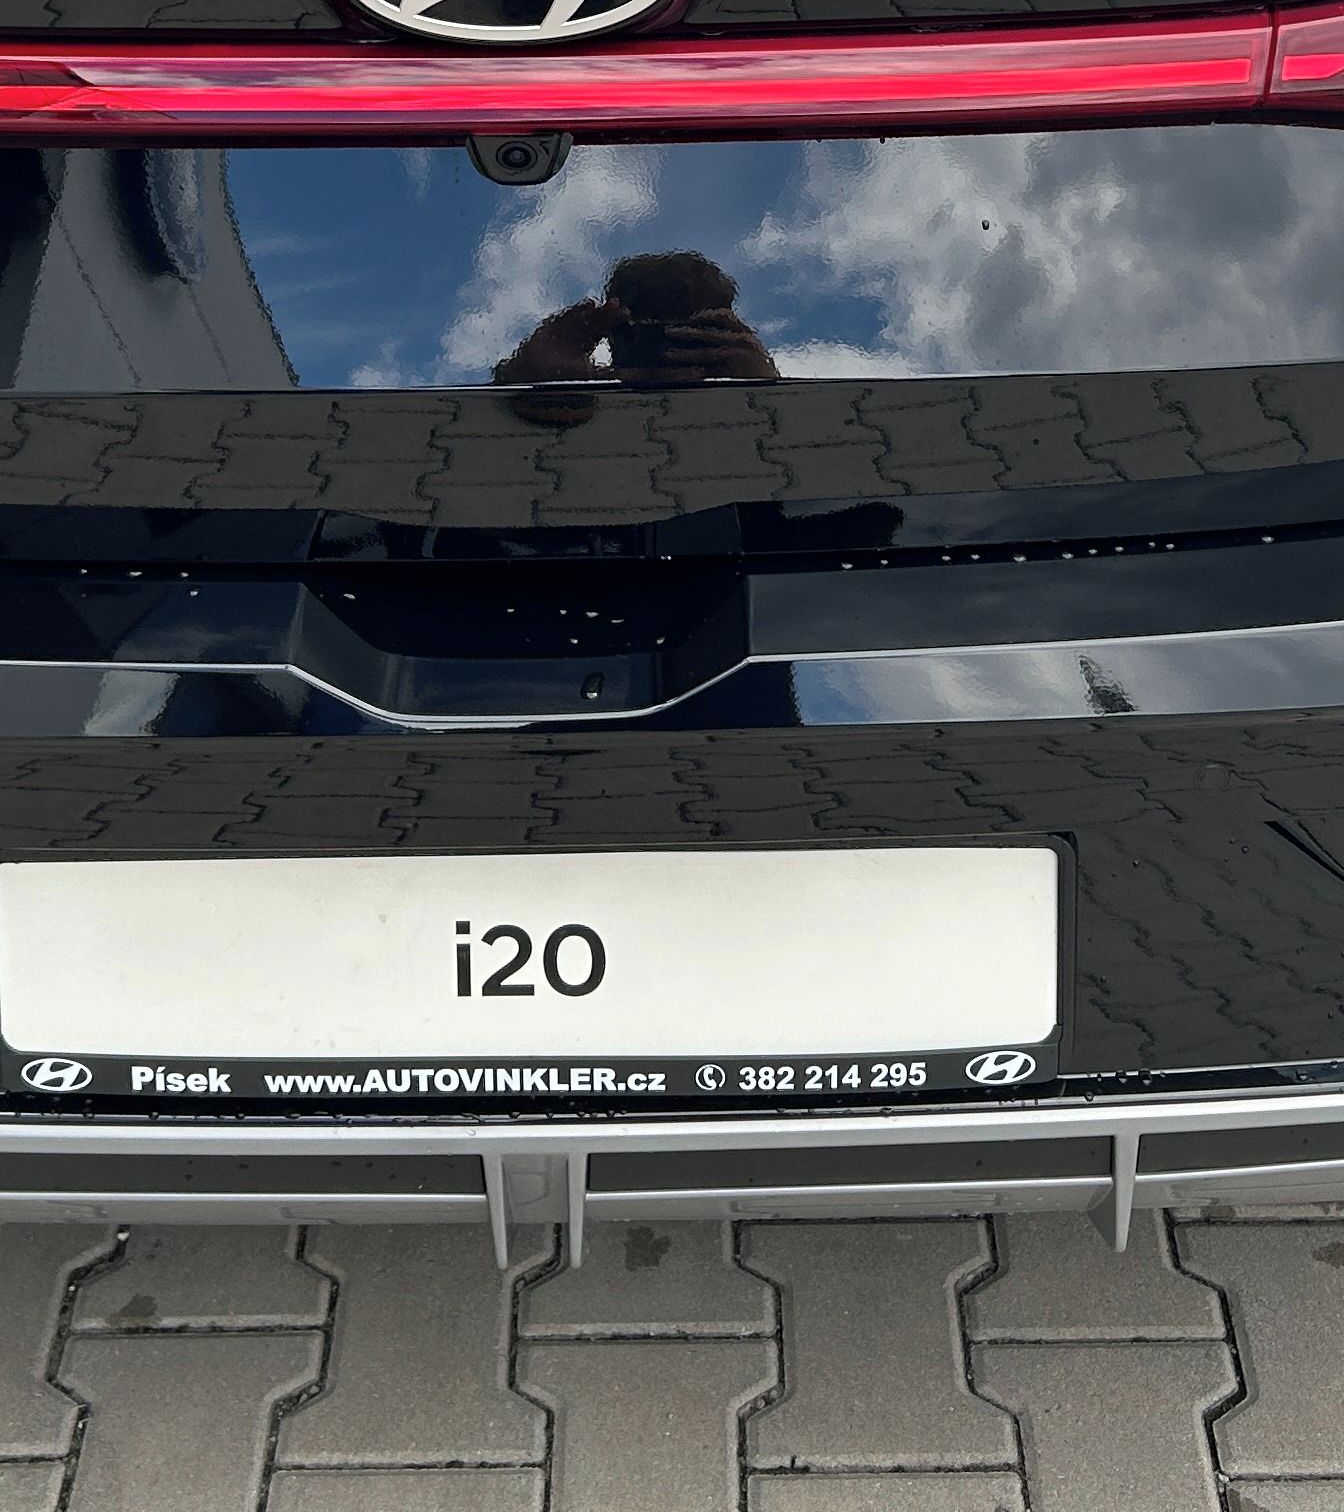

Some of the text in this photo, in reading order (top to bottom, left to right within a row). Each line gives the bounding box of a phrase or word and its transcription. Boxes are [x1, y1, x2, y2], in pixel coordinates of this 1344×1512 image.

[455, 921, 606, 997] i20
[130, 1061, 928, 1093] Písek www.AUTOVINKLER.cz 382 214 295
